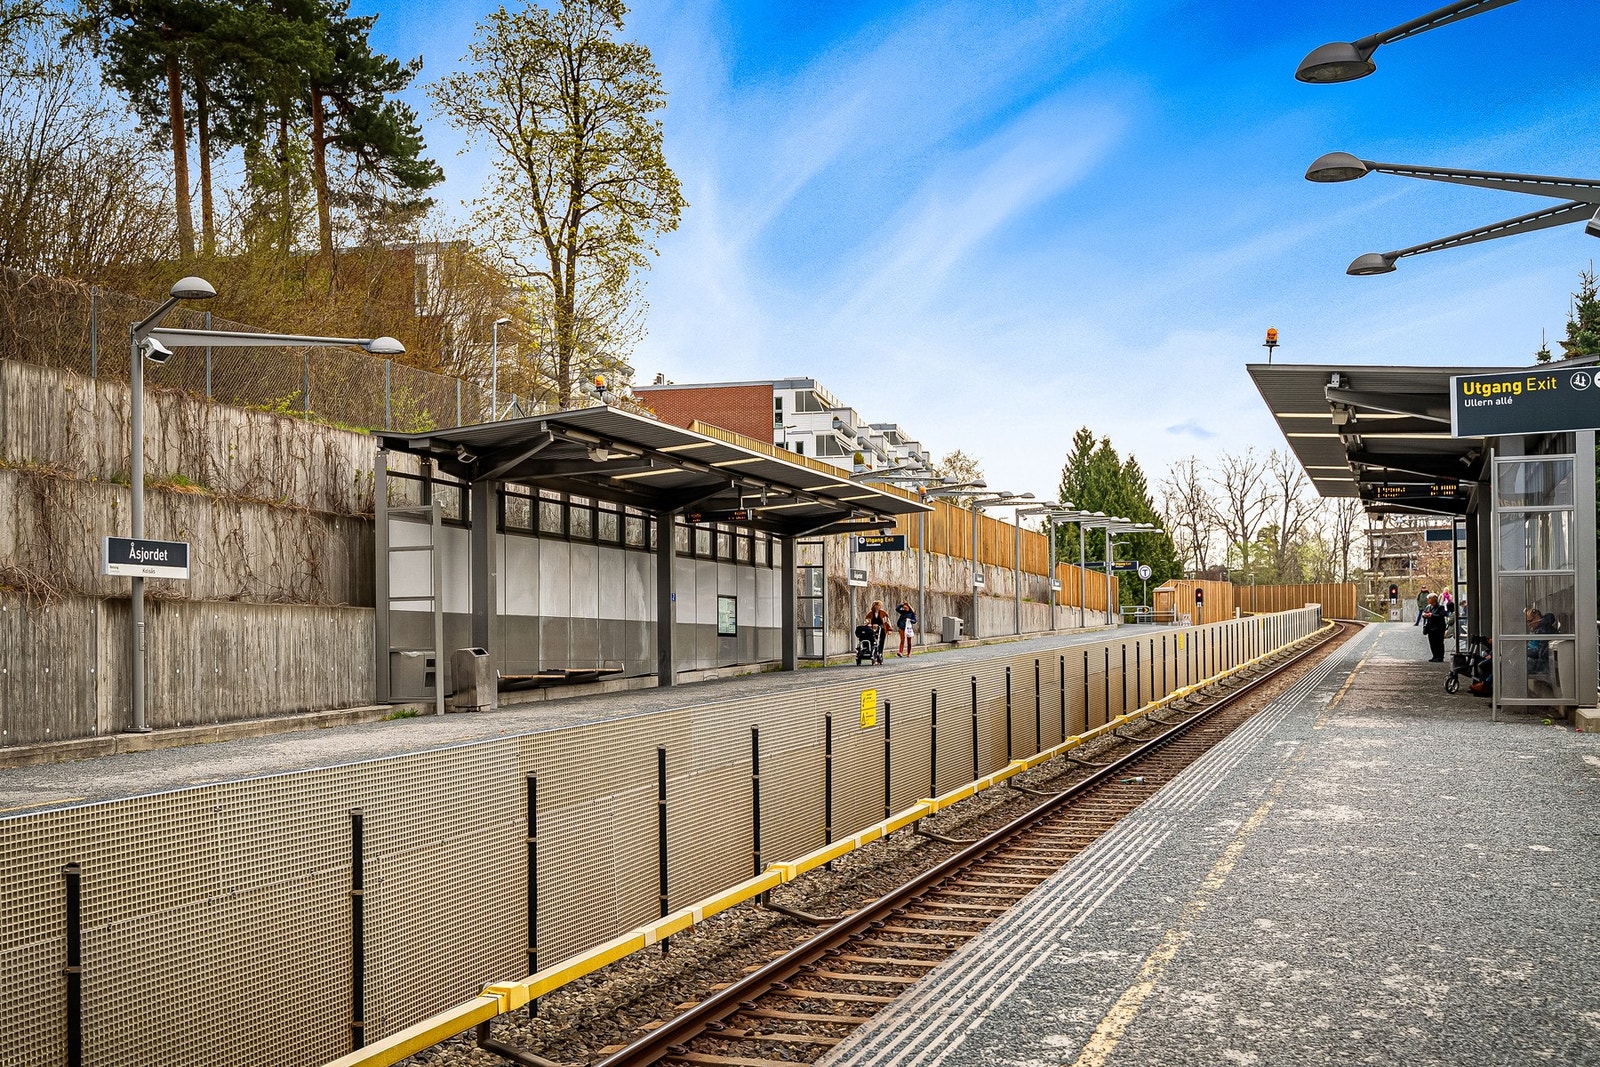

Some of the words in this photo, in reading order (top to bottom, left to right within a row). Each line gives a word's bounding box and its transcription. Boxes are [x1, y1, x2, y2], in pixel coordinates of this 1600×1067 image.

[1463, 381, 1522, 397] Utgang
[1526, 377, 1557, 391] Exit
[1464, 399, 1493, 407] Ullern
[1495, 396, 1513, 405] allé
[129, 541, 168, 562] Åsjordet
